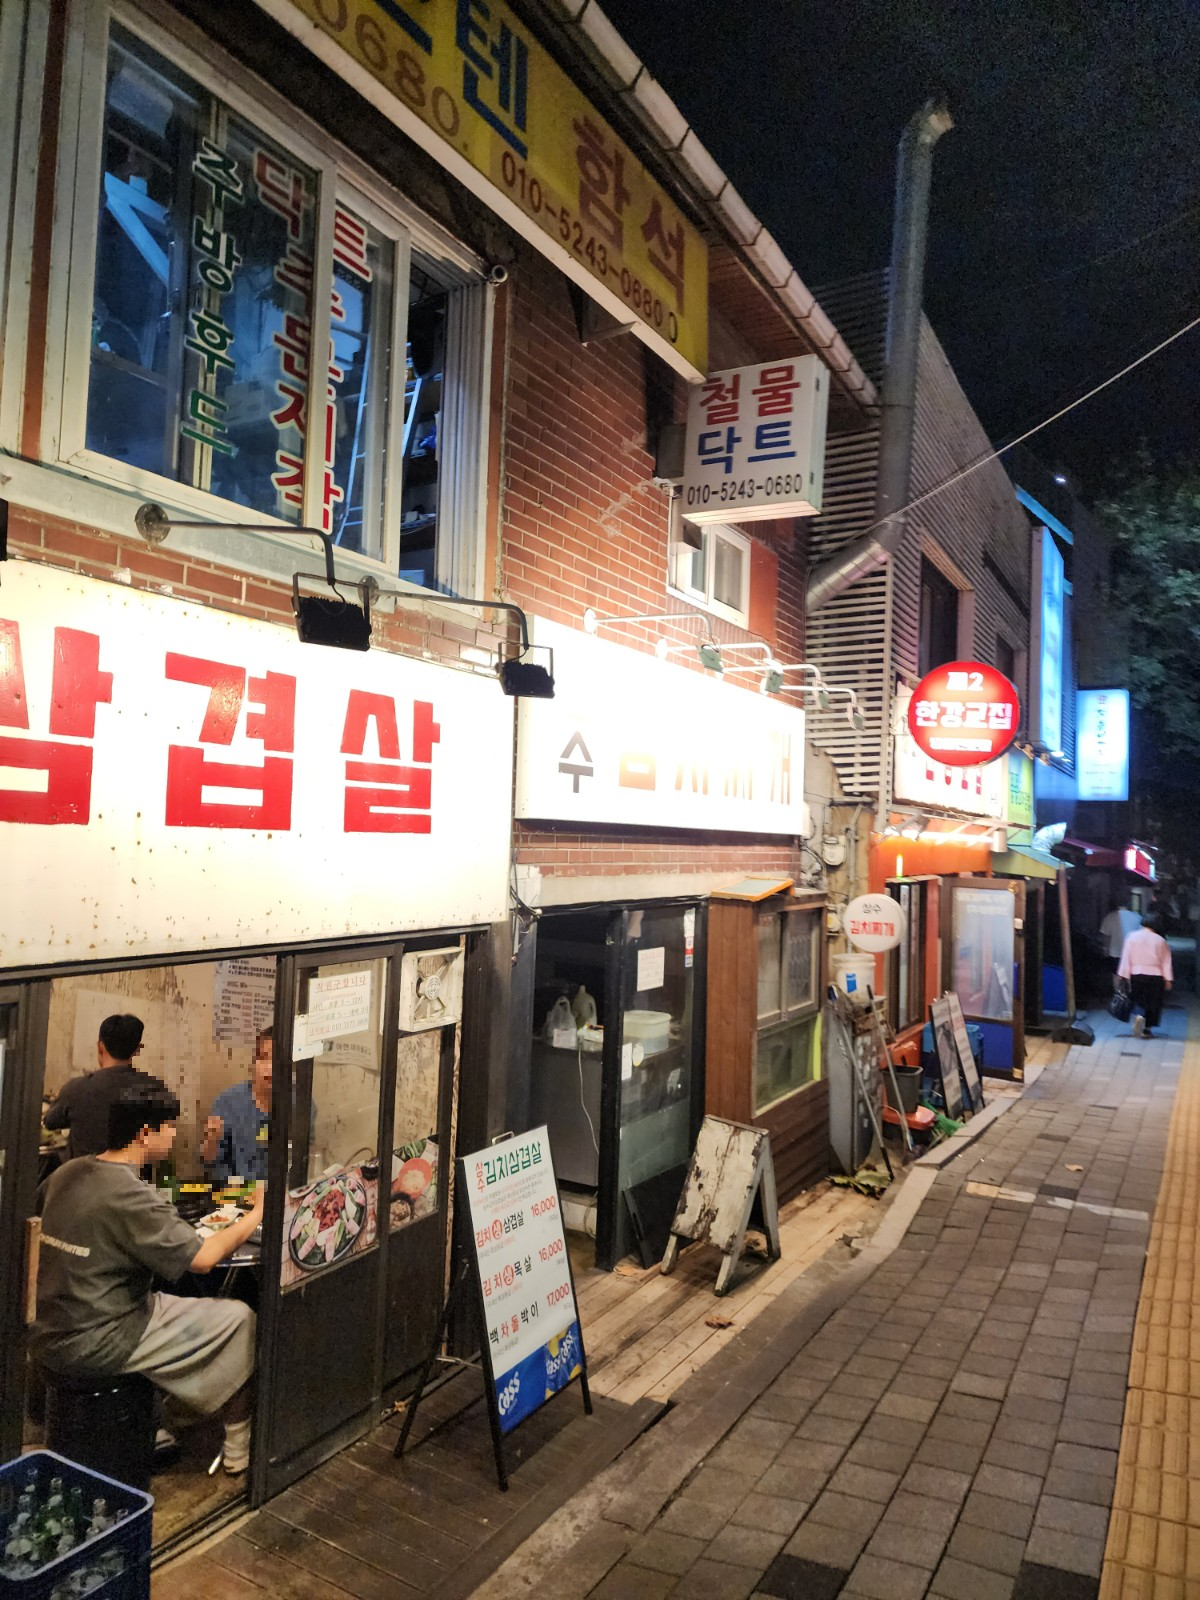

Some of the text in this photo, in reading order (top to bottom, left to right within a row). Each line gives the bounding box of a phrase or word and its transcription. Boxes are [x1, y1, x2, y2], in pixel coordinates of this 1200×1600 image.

[181, 138, 244, 459] 주방후드
[700, 365, 801, 425] 철물
[698, 421, 798, 474] 닥트
[687, 473, 803, 505] 010-5243-0680
[484, 1141, 542, 1186] 김치삼겹살
[531, 1195, 556, 1217] 16,000
[539, 1239, 563, 1262] 16,000
[547, 1283, 570, 1306] 17,000
